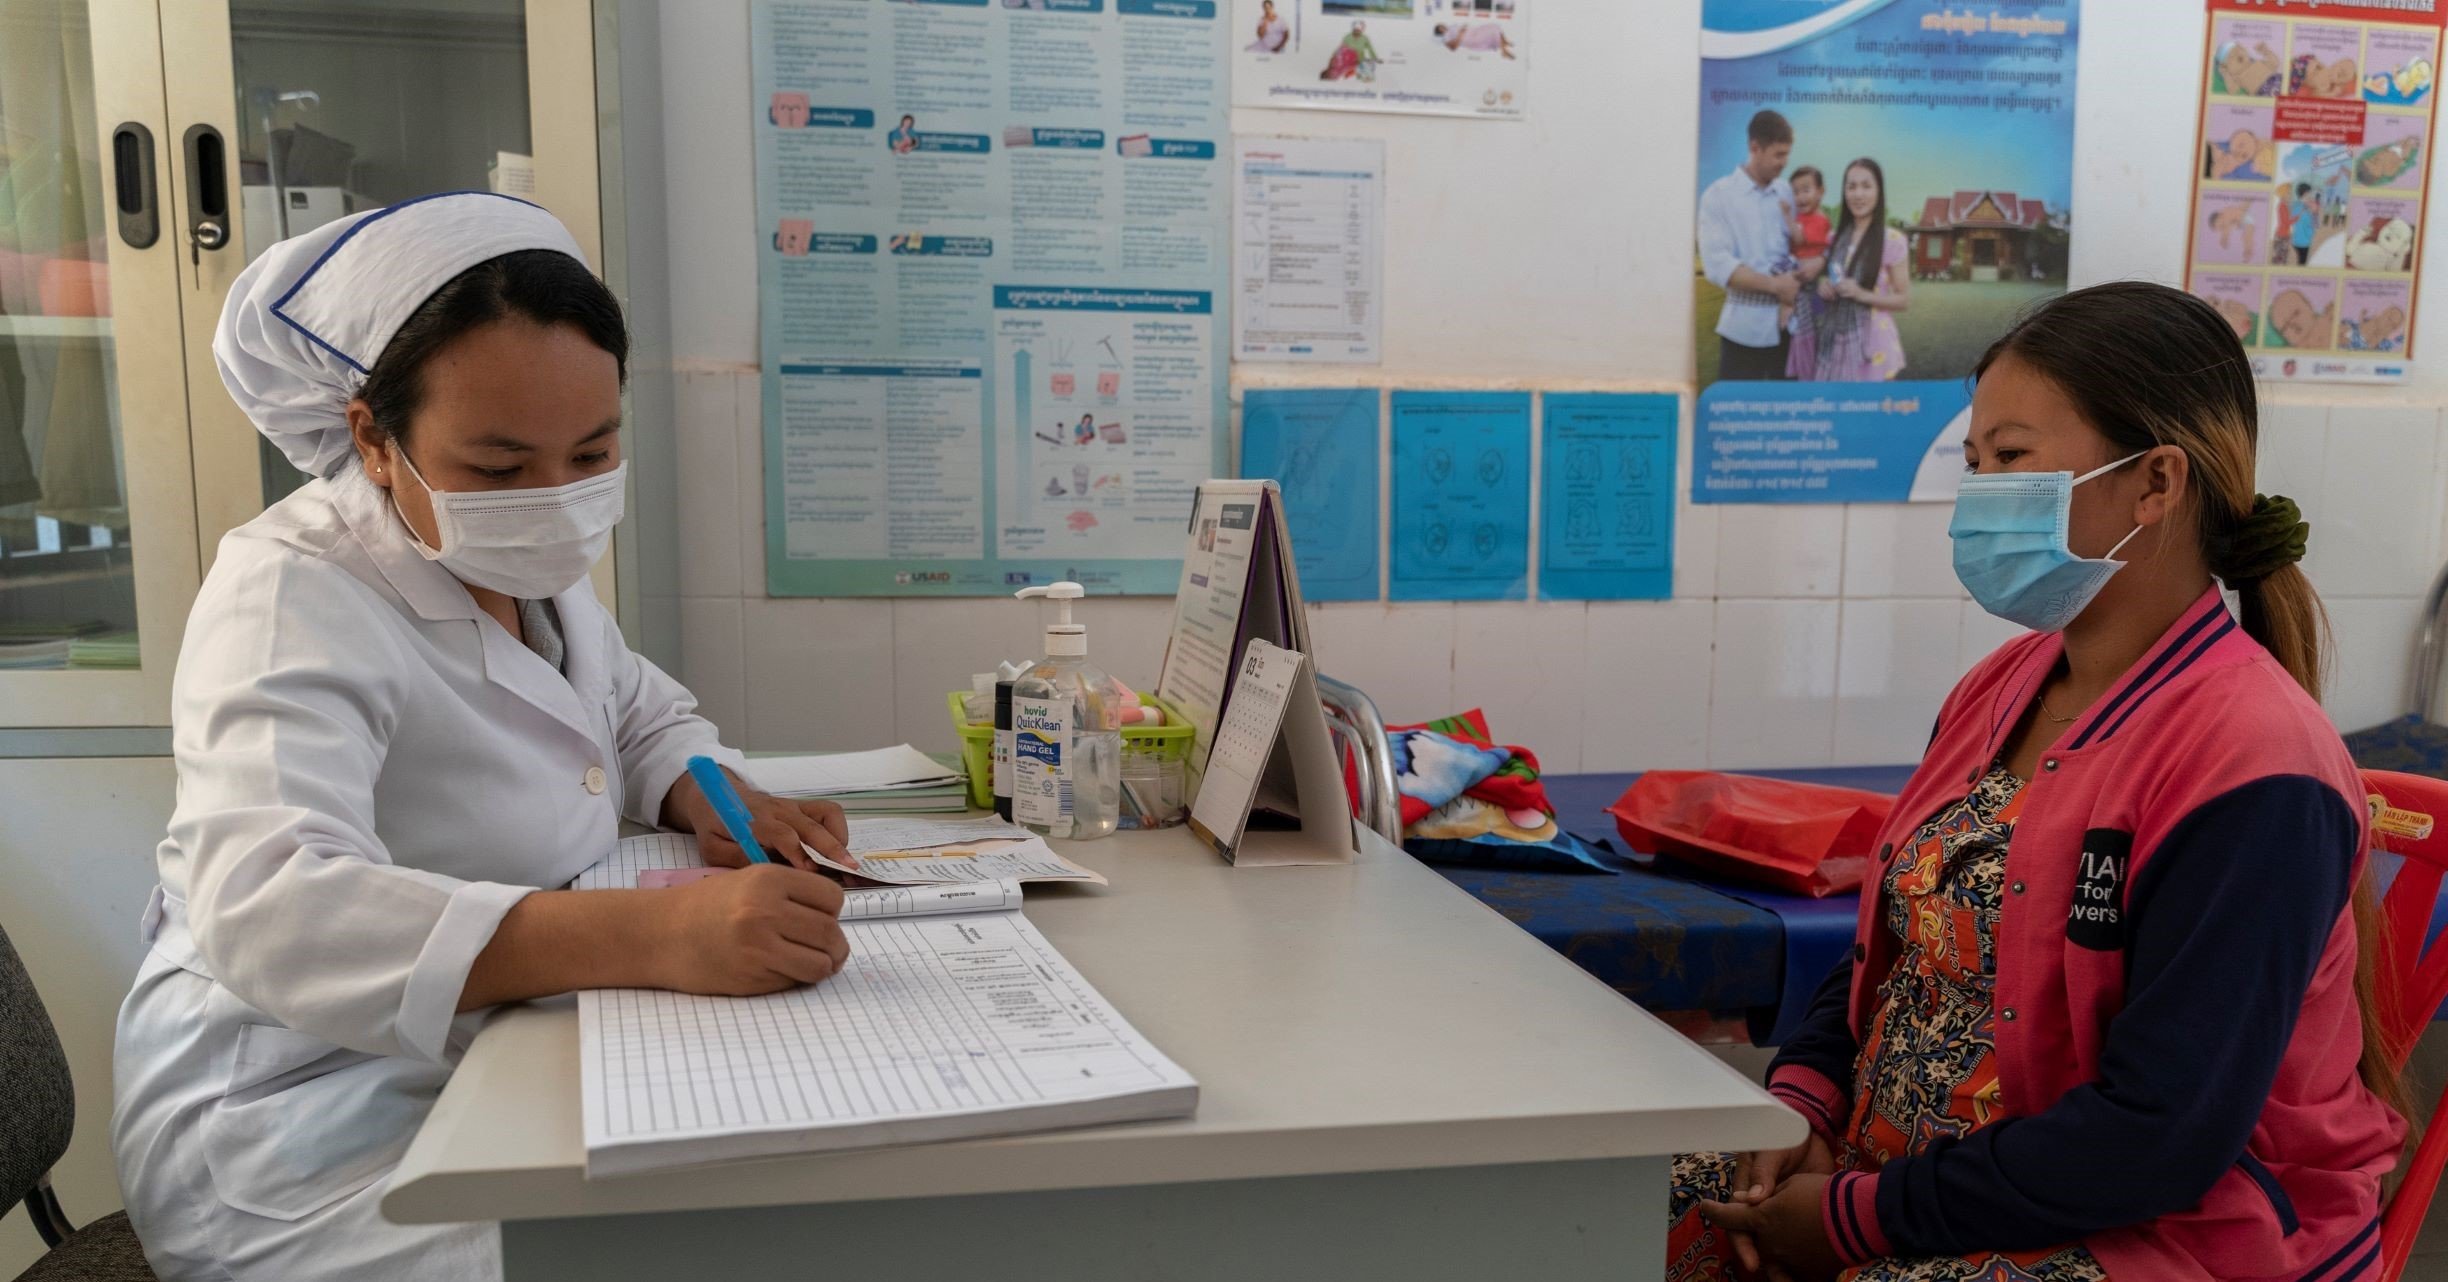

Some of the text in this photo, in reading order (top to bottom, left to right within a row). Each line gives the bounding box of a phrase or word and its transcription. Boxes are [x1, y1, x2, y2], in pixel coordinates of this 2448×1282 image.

[912, 572, 951, 582] USAID
[1246, 656, 1258, 676] 03
[1024, 705, 1048, 717] hovid
[1017, 743, 1055, 755] HAND GEL
[2082, 880, 2113, 900] for
